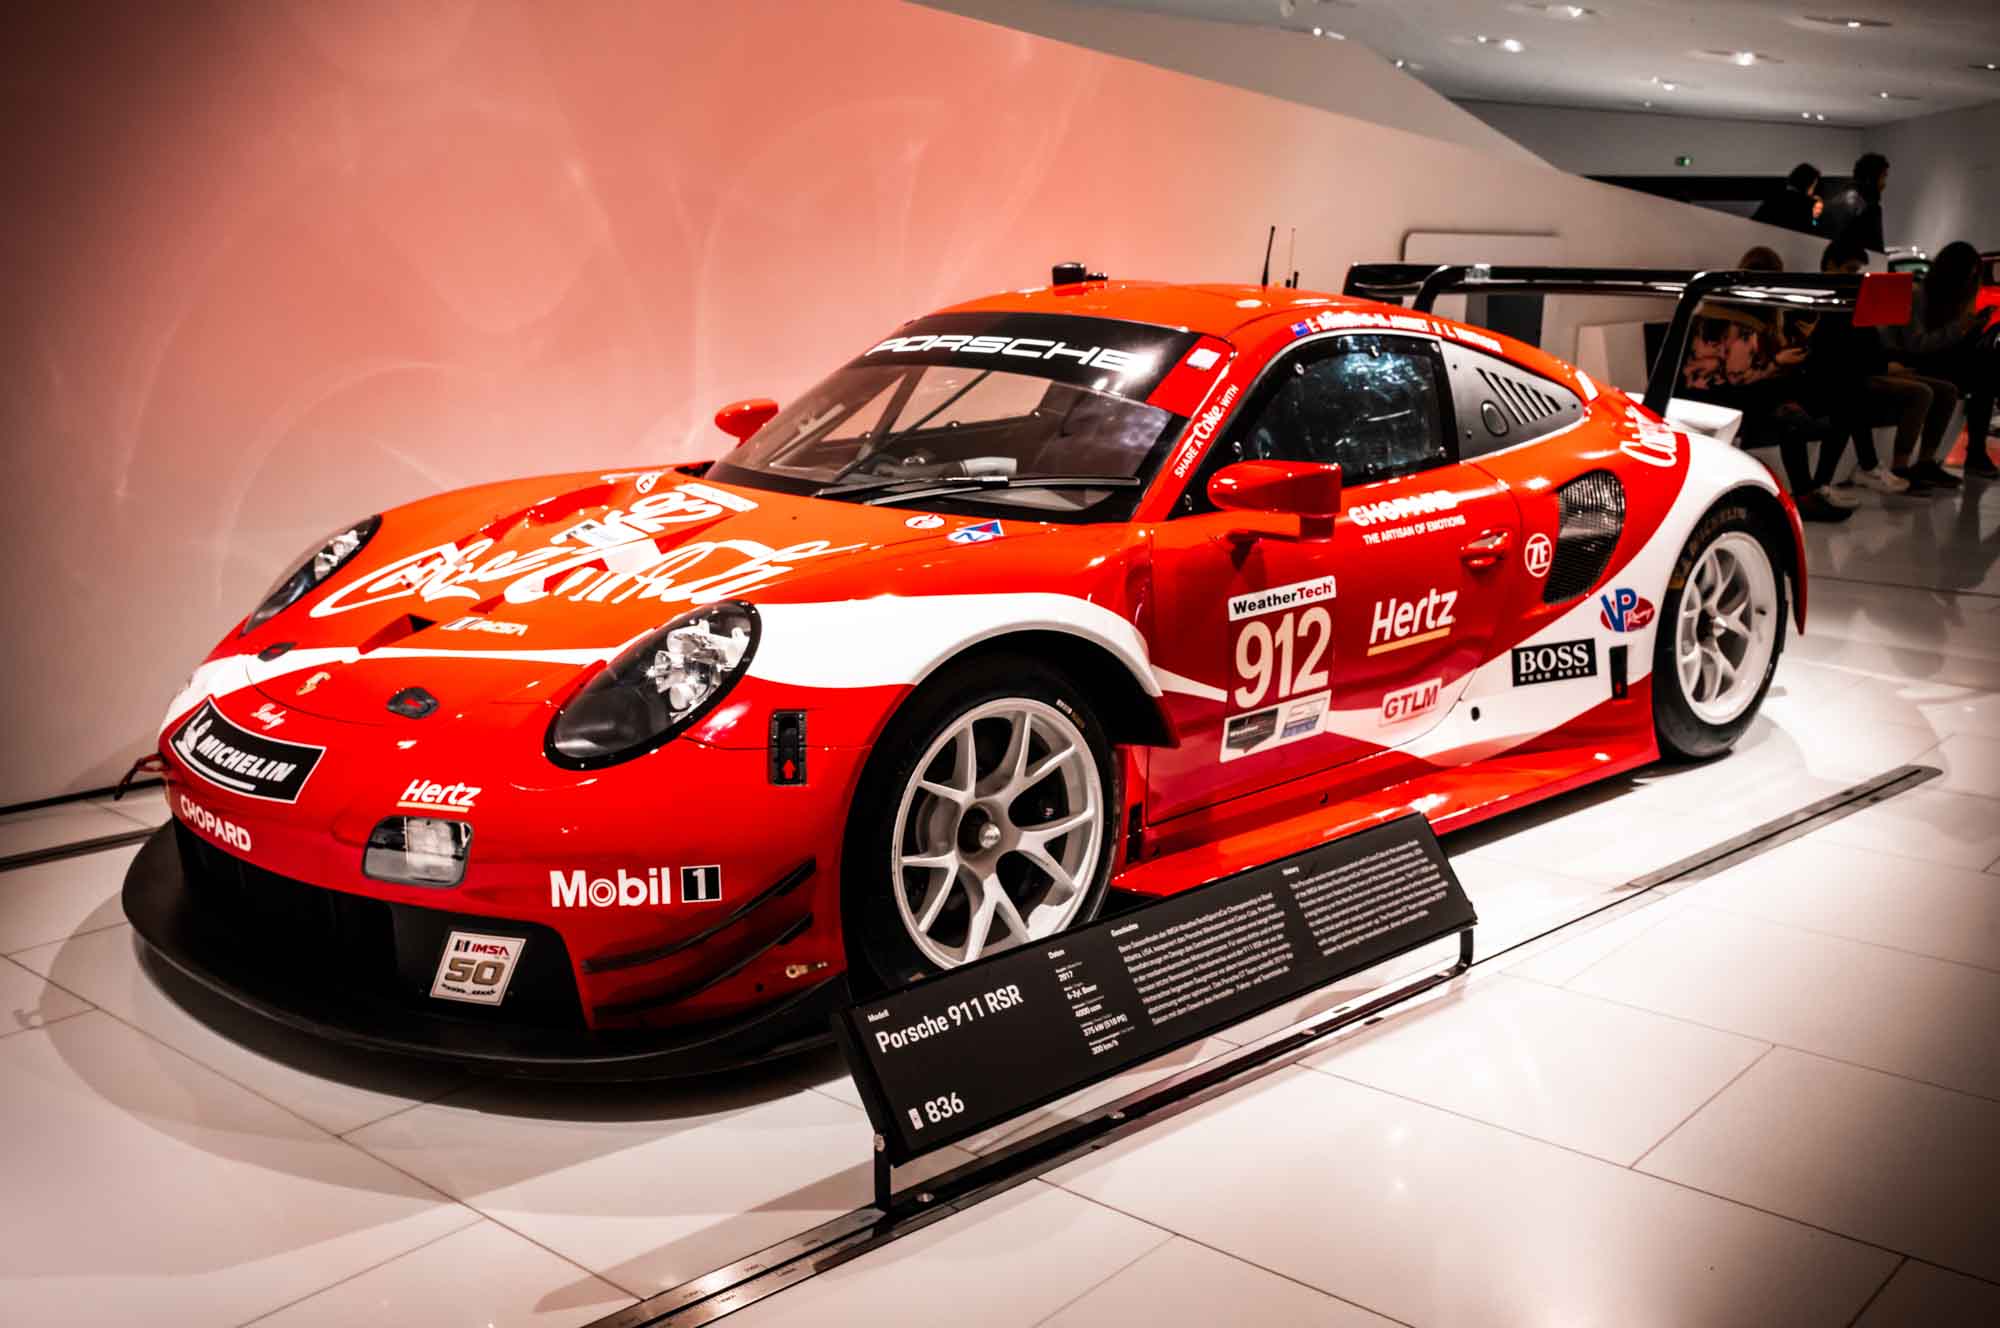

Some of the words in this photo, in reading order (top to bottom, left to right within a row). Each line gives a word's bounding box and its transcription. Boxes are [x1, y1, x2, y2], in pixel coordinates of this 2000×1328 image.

[864, 335, 1150, 374] PORSCHE
[1219, 384, 1239, 407] WITH
[1193, 405, 1225, 439] Coke
[1194, 439, 1205, 449] A
[1174, 446, 1199, 478] SHARE
[1348, 490, 1458, 526] CHOPARD
[1363, 532, 1380, 544] THE
[1381, 525, 1415, 542] ARTISAN
[1414, 522, 1426, 534] OF
[1425, 514, 1466, 532] EMOTIONS
[1233, 582, 1332, 614] WeatherTech
[1601, 588, 1637, 632] VP
[1369, 588, 1458, 644] Hertz
[1234, 606, 1332, 708] 912
[1519, 643, 1589, 674] BOSS
[1384, 685, 1439, 718] GTLM
[196, 733, 297, 782] MICHELIN
[401, 779, 482, 806] Hertz
[181, 795, 252, 852] CHOPARD
[549, 866, 671, 908] Mobil
[444, 957, 505, 986] 50
[875, 1015, 949, 1053] Porsche
[947, 997, 985, 1026] 911
[984, 984, 1024, 1014] RSR
[924, 1092, 965, 1123] 836
